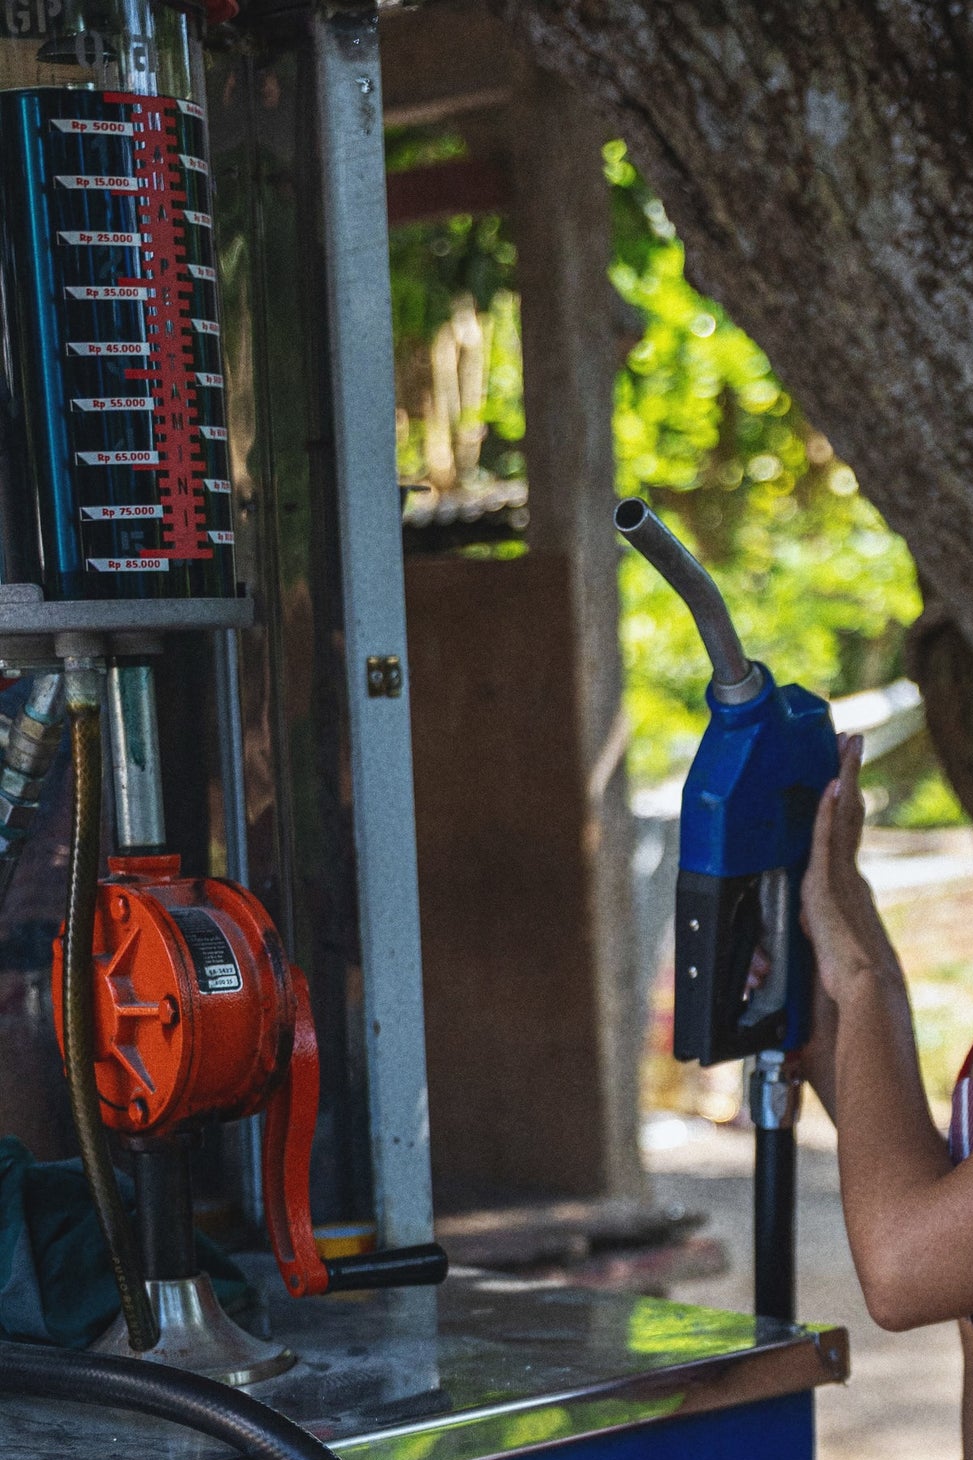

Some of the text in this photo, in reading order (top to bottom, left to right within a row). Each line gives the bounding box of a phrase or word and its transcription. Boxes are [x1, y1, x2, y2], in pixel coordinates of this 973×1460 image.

[71, 120, 125, 133] Rp 5000
[75, 177, 130, 188] Rp 15.000
[79, 233, 133, 244] Rp 25.000
[85, 288, 139, 299] Rp 35.000
[88, 343, 142, 356] Rp 45.000
[92, 398, 146, 410] Rp 55.000
[96, 452, 151, 464] Rp 65.000
[102, 506, 155, 518] Rp 75.000
[107, 559, 161, 570] Rp 85.000
